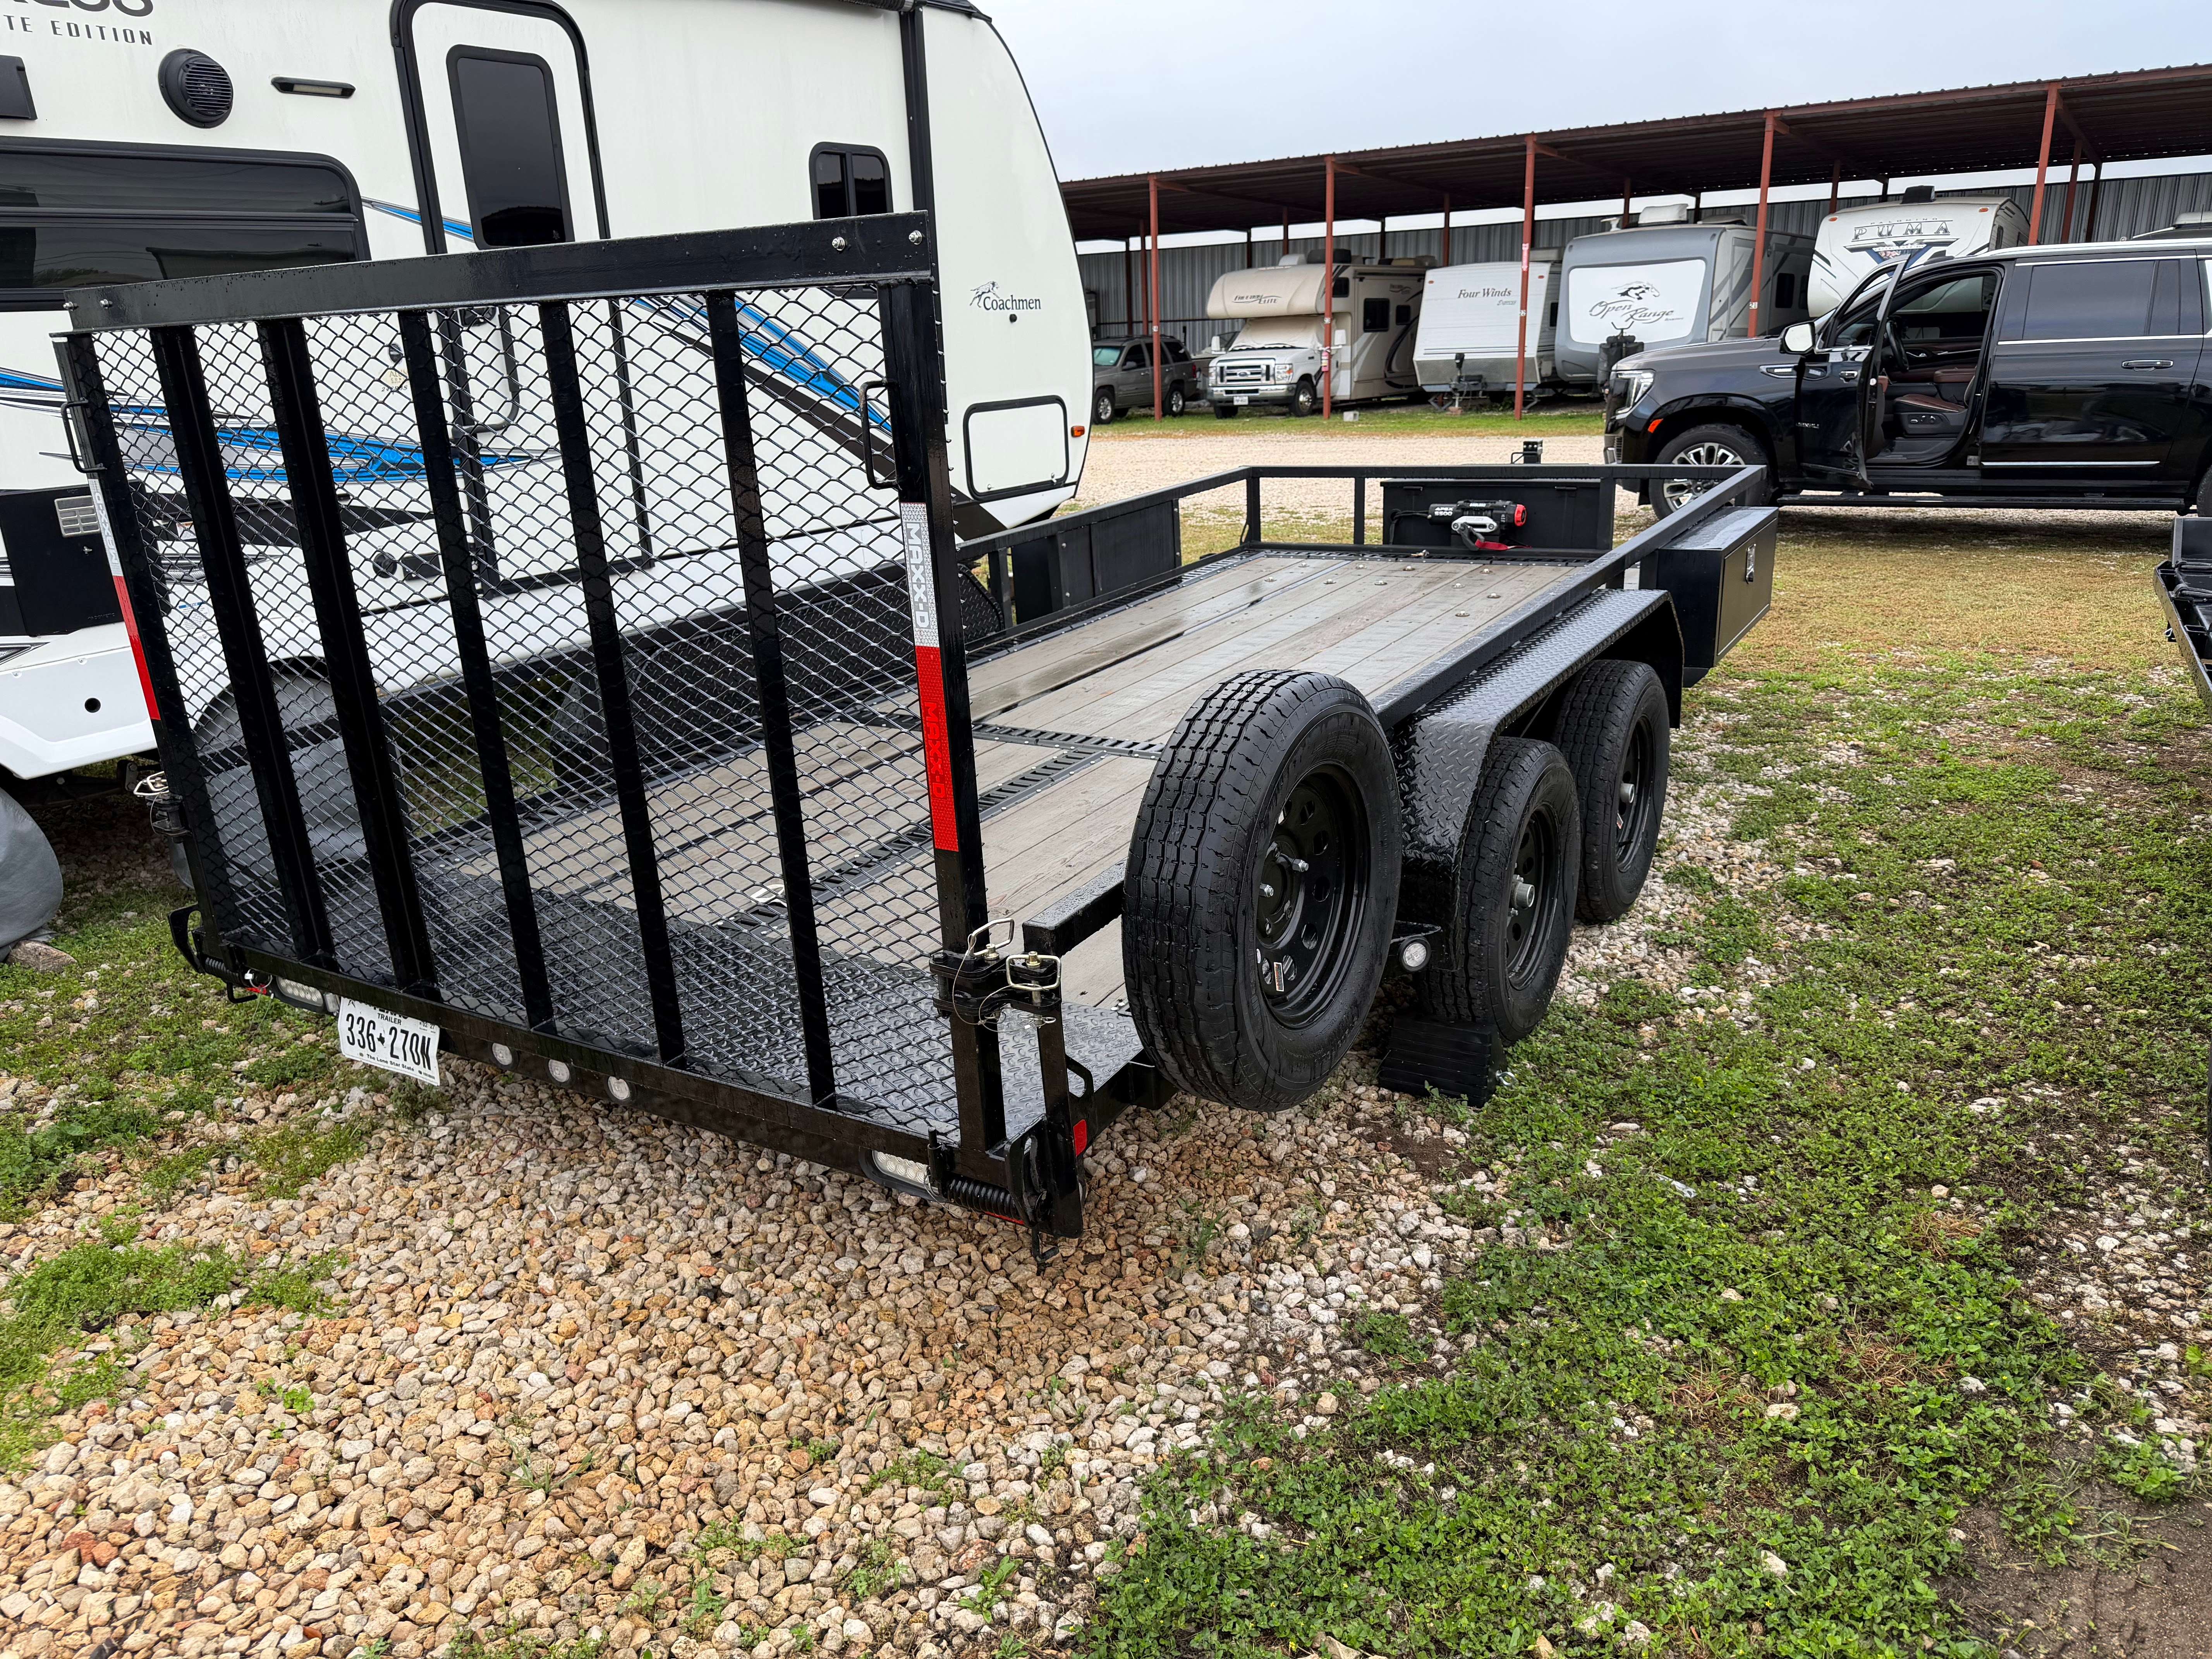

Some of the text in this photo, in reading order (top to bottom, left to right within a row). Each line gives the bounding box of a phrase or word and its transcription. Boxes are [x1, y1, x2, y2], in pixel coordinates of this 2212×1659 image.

[51, 20, 152, 45] EDITION
[1852, 222, 1950, 240] PUMA
[983, 295, 1041, 311] Coachmen
[1458, 288, 1511, 299] Four Winds
[1589, 300, 1634, 319] Open
[1620, 307, 1674, 324] Range
[95, 491, 119, 564] MAXX-D
[907, 523, 929, 628] MAXX-D
[924, 702, 945, 798] MAXX-D
[377, 1013, 402, 1025] TRAILER
[346, 1013, 431, 1071] 336 270N
